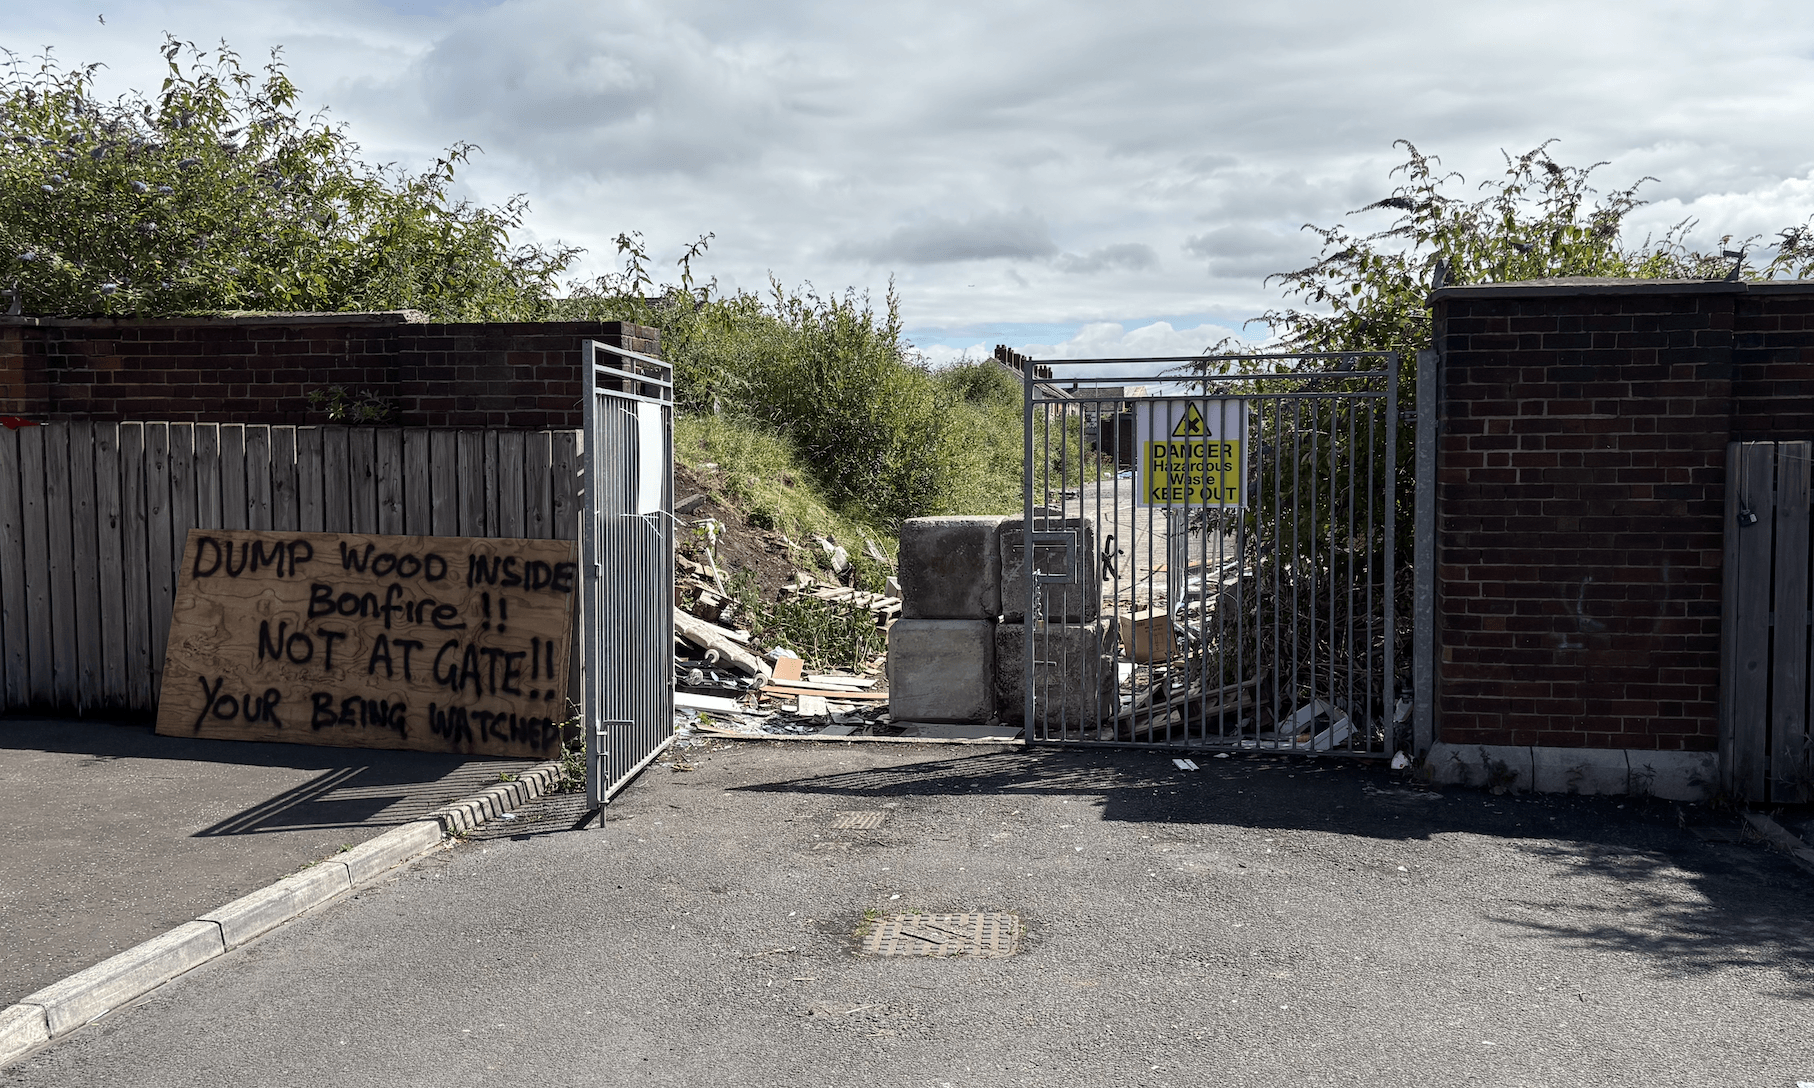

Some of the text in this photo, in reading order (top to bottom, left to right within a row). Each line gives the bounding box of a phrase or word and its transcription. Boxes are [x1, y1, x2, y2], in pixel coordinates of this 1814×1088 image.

[1154, 444, 1232, 459] DANGER
[1150, 487, 1237, 501] KEEP OUT
[1169, 473, 1216, 485] Wase
[193, 536, 577, 593] DUMP WOOD INSIDE
[258, 620, 346, 671] NOT
[368, 634, 423, 684] AT
[193, 676, 560, 751] YOUR BEING WATCHED
